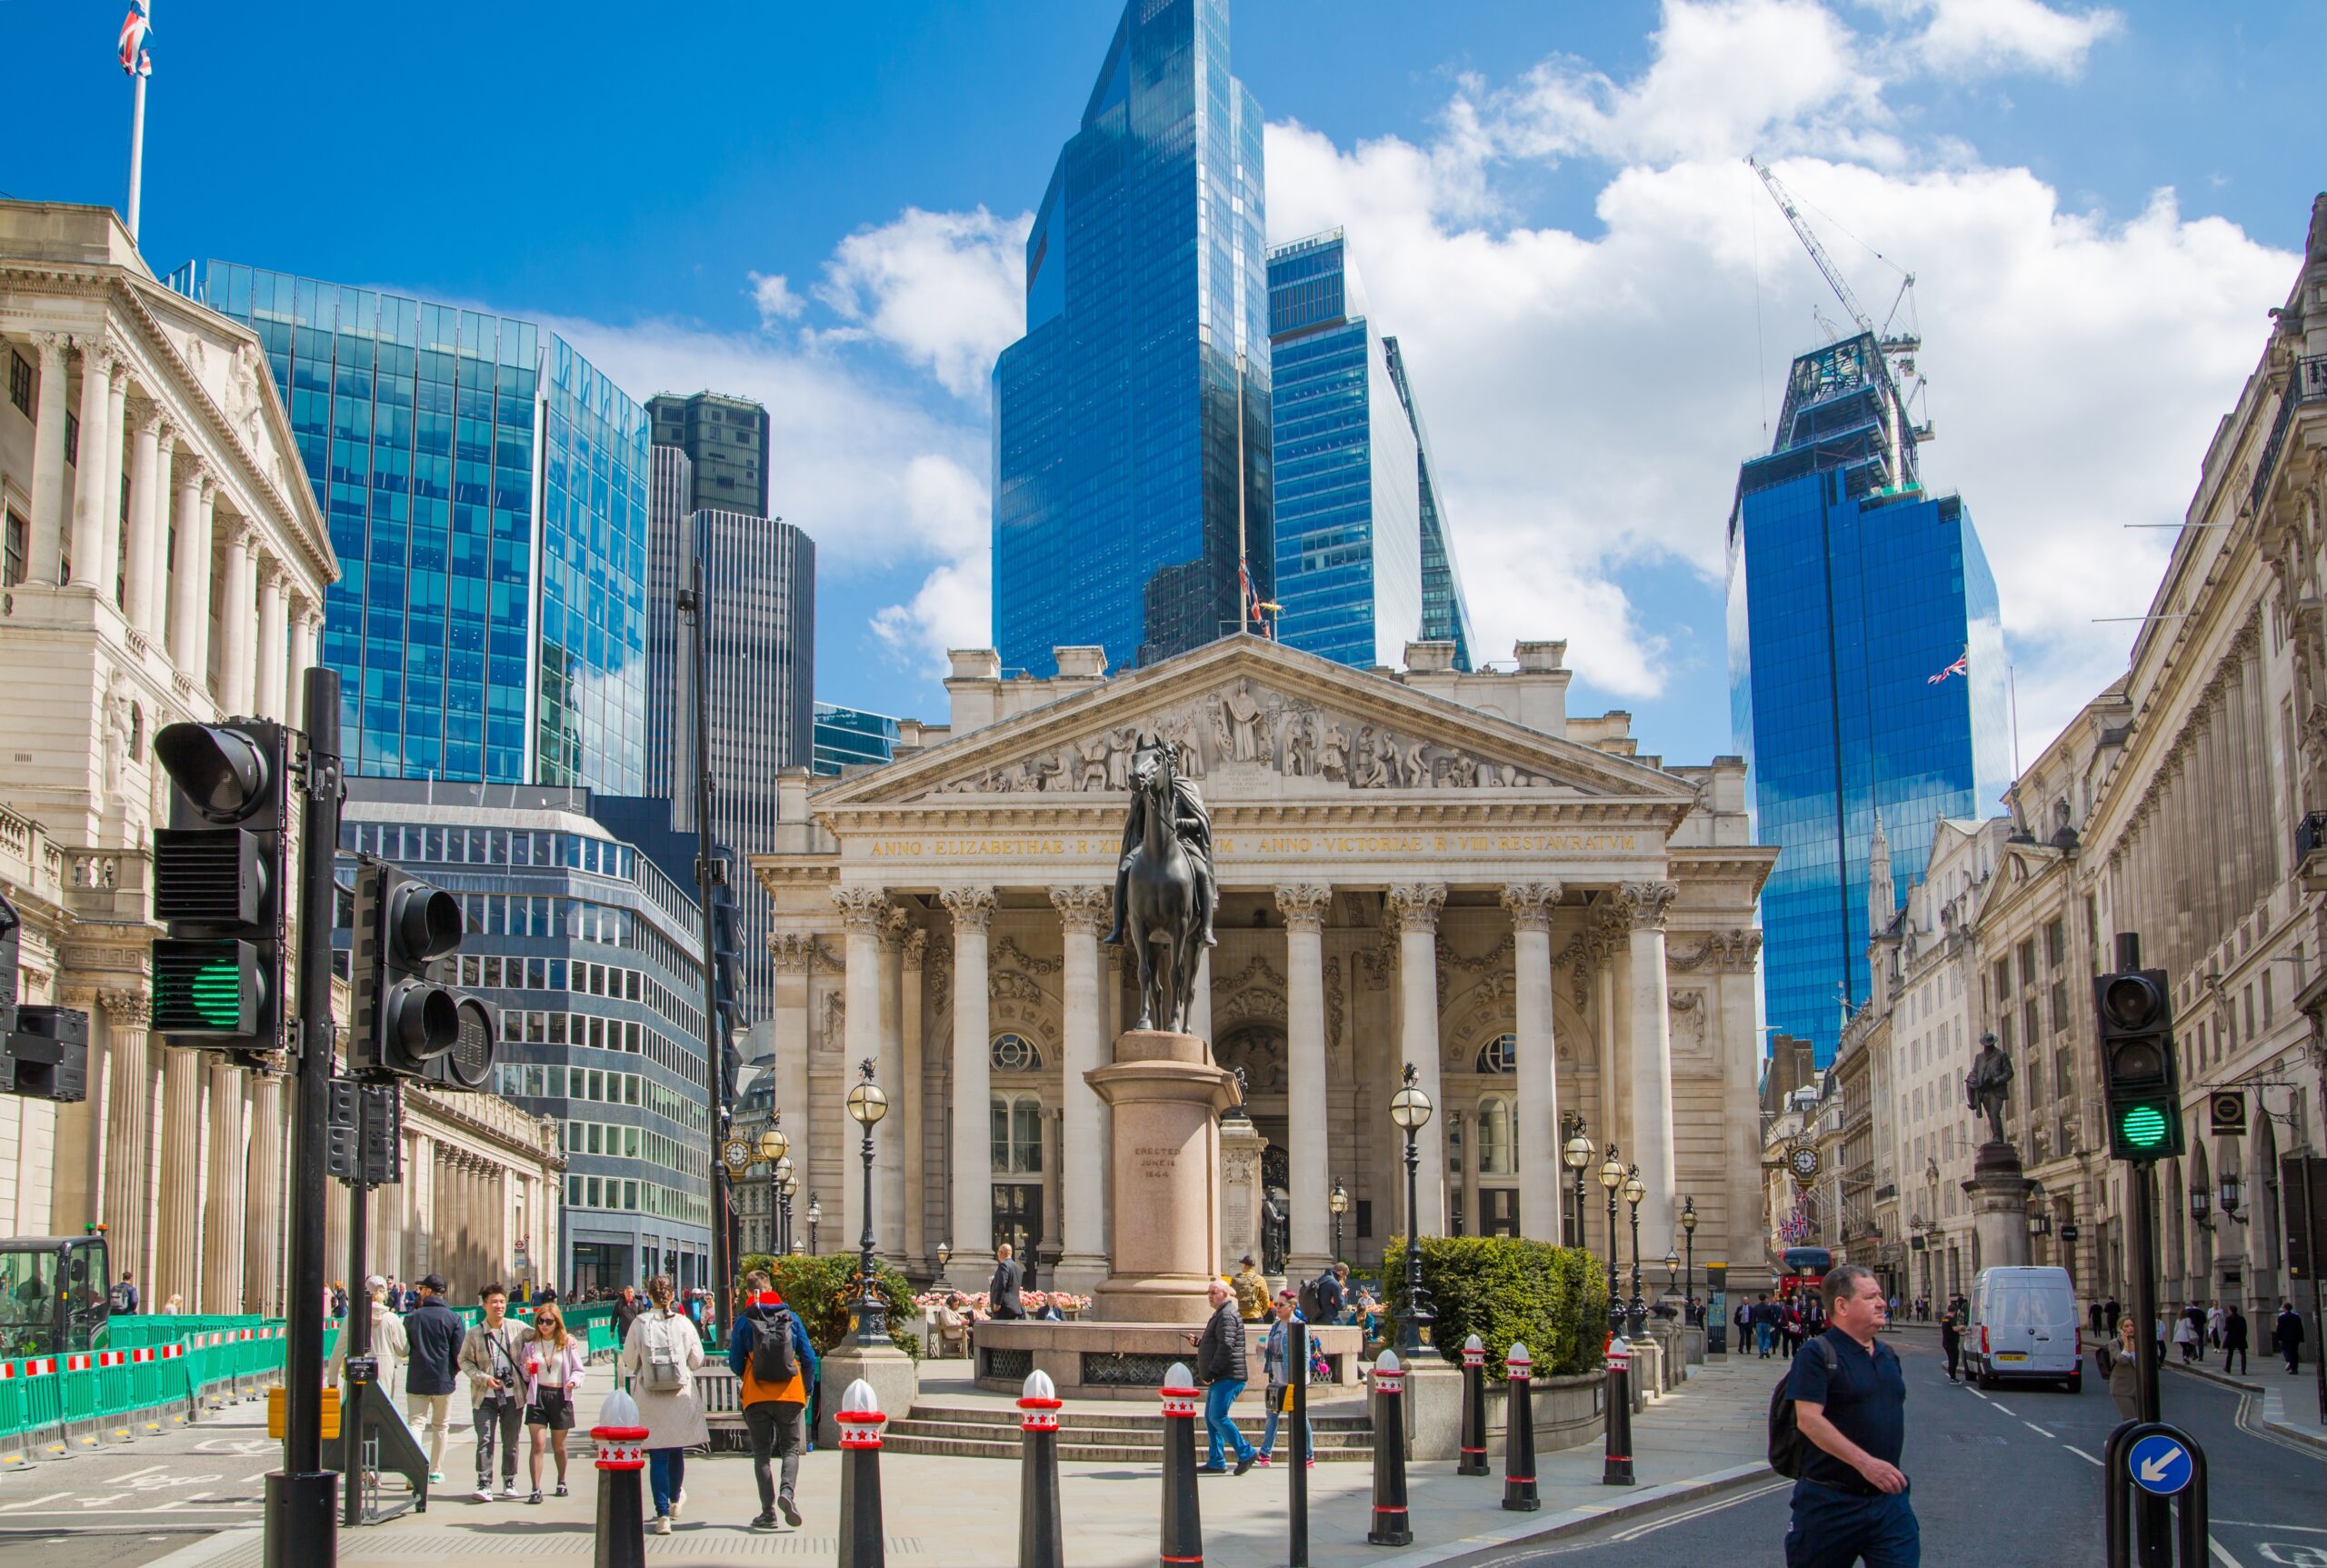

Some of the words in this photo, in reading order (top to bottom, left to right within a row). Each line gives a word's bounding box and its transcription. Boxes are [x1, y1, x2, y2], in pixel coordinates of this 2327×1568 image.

[871, 842, 923, 855] ANNO
[935, 840, 1064, 854] ELIZABETHAE
[1077, 840, 1088, 854] R
[1257, 839, 1312, 853] ANNO
[1323, 838, 1423, 852] VICTORIAE
[1434, 837, 1447, 851] R
[1458, 837, 1487, 851] VIII
[1498, 836, 1634, 850] RESTAVRATVM
